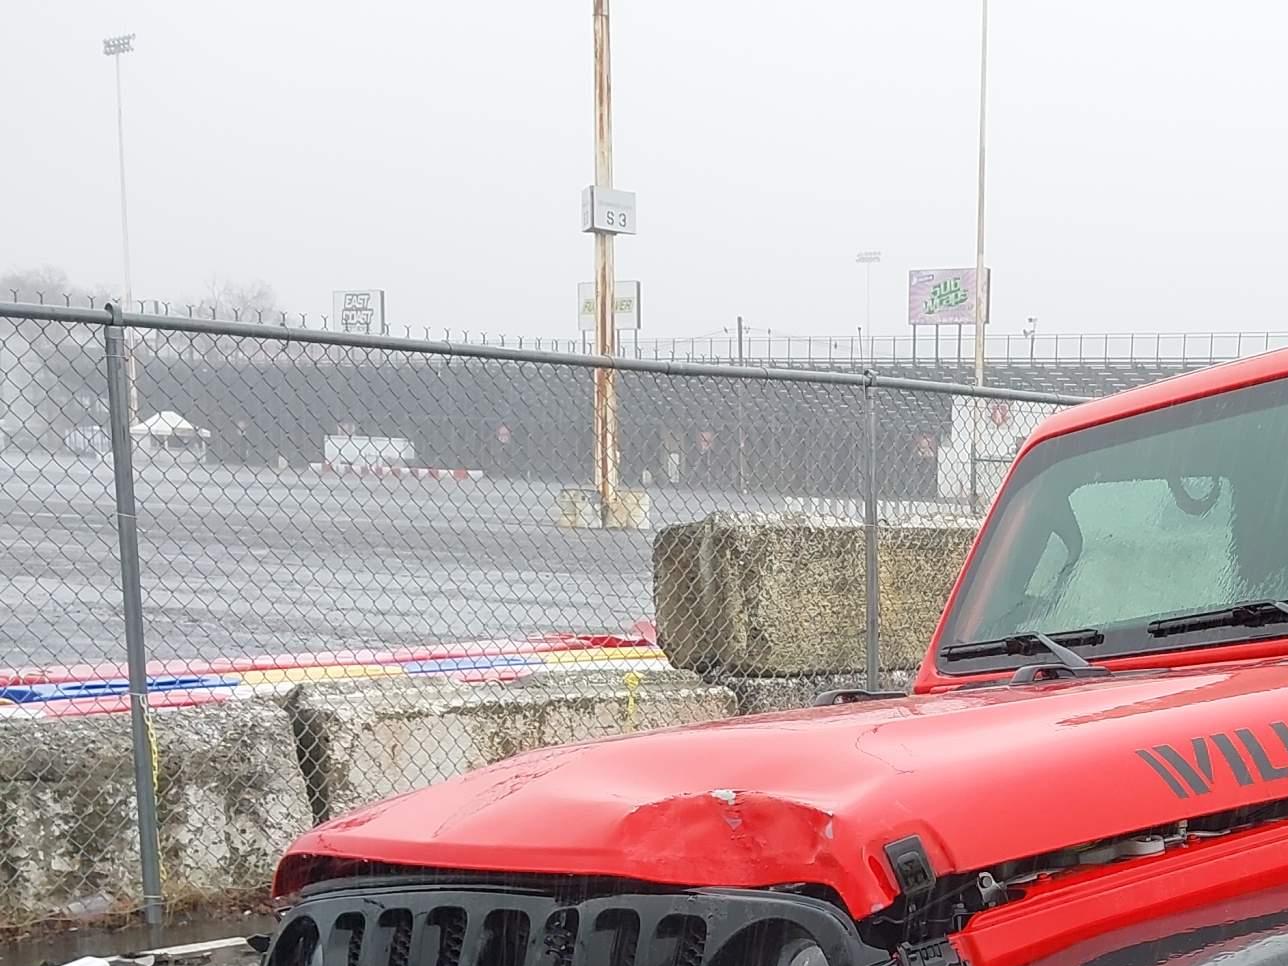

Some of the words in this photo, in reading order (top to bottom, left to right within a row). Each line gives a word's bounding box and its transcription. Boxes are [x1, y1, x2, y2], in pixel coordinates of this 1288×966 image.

[606, 210, 615, 226] S
[618, 212, 627, 228] 3
[344, 293, 370, 310] EAST
